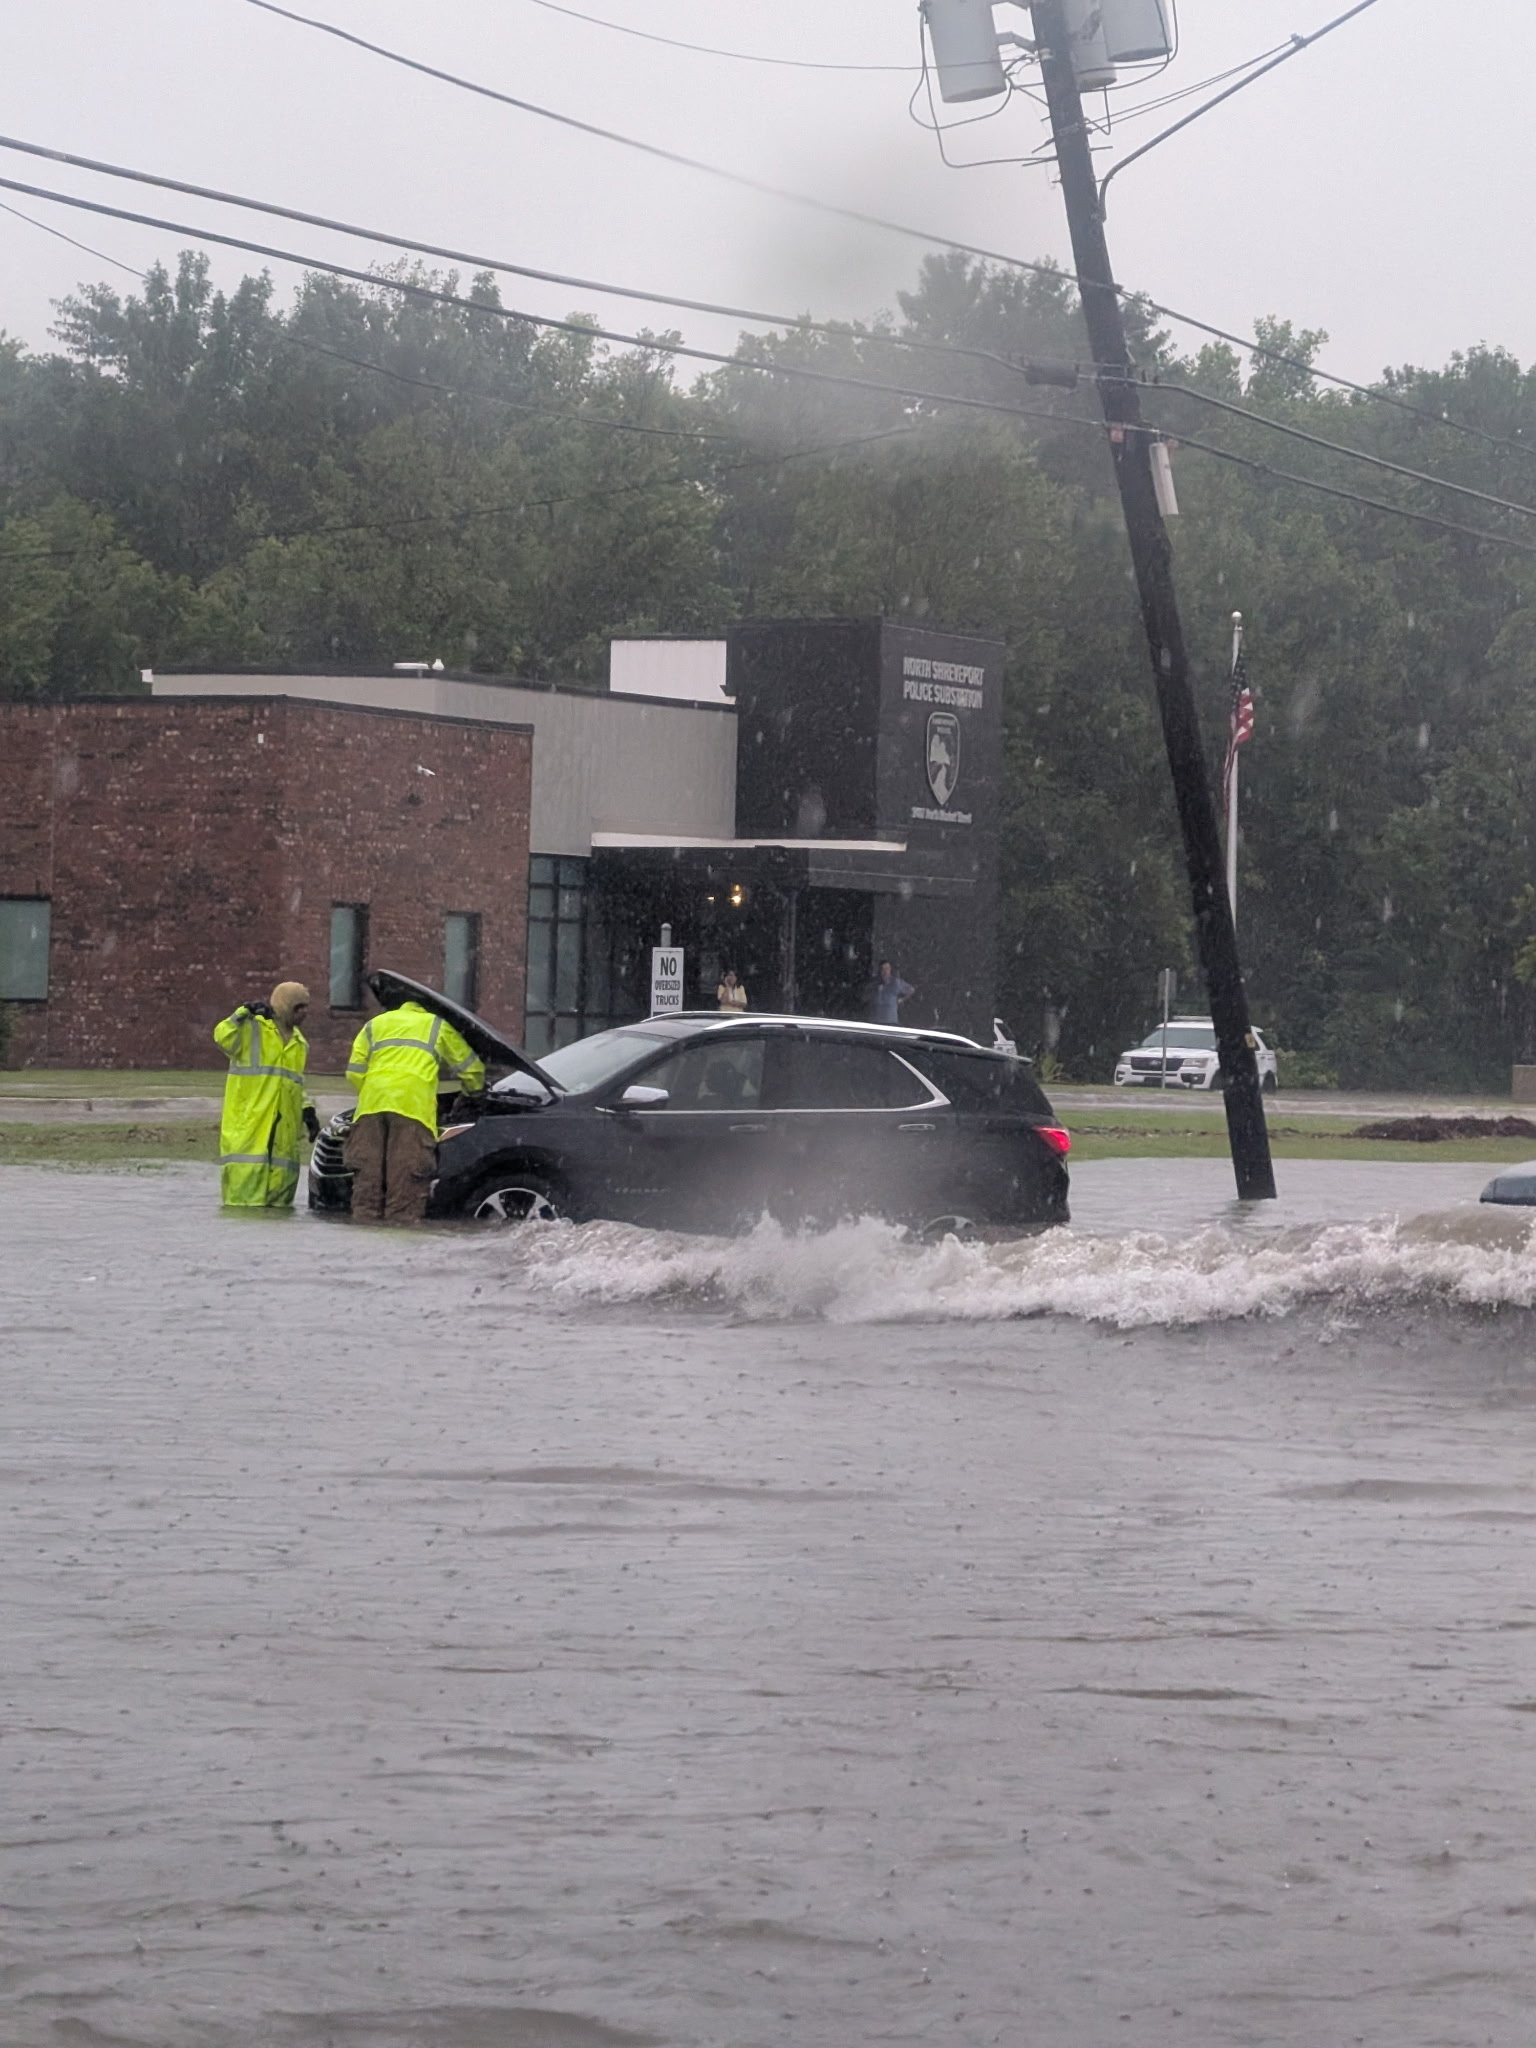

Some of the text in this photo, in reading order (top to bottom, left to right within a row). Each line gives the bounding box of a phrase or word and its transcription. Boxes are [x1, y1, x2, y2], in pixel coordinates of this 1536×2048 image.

[903, 656, 931, 678] NORTH
[903, 681, 933, 702] POLICE
[660, 957, 677, 976] NO
[656, 994, 680, 1006] TRUCKS
